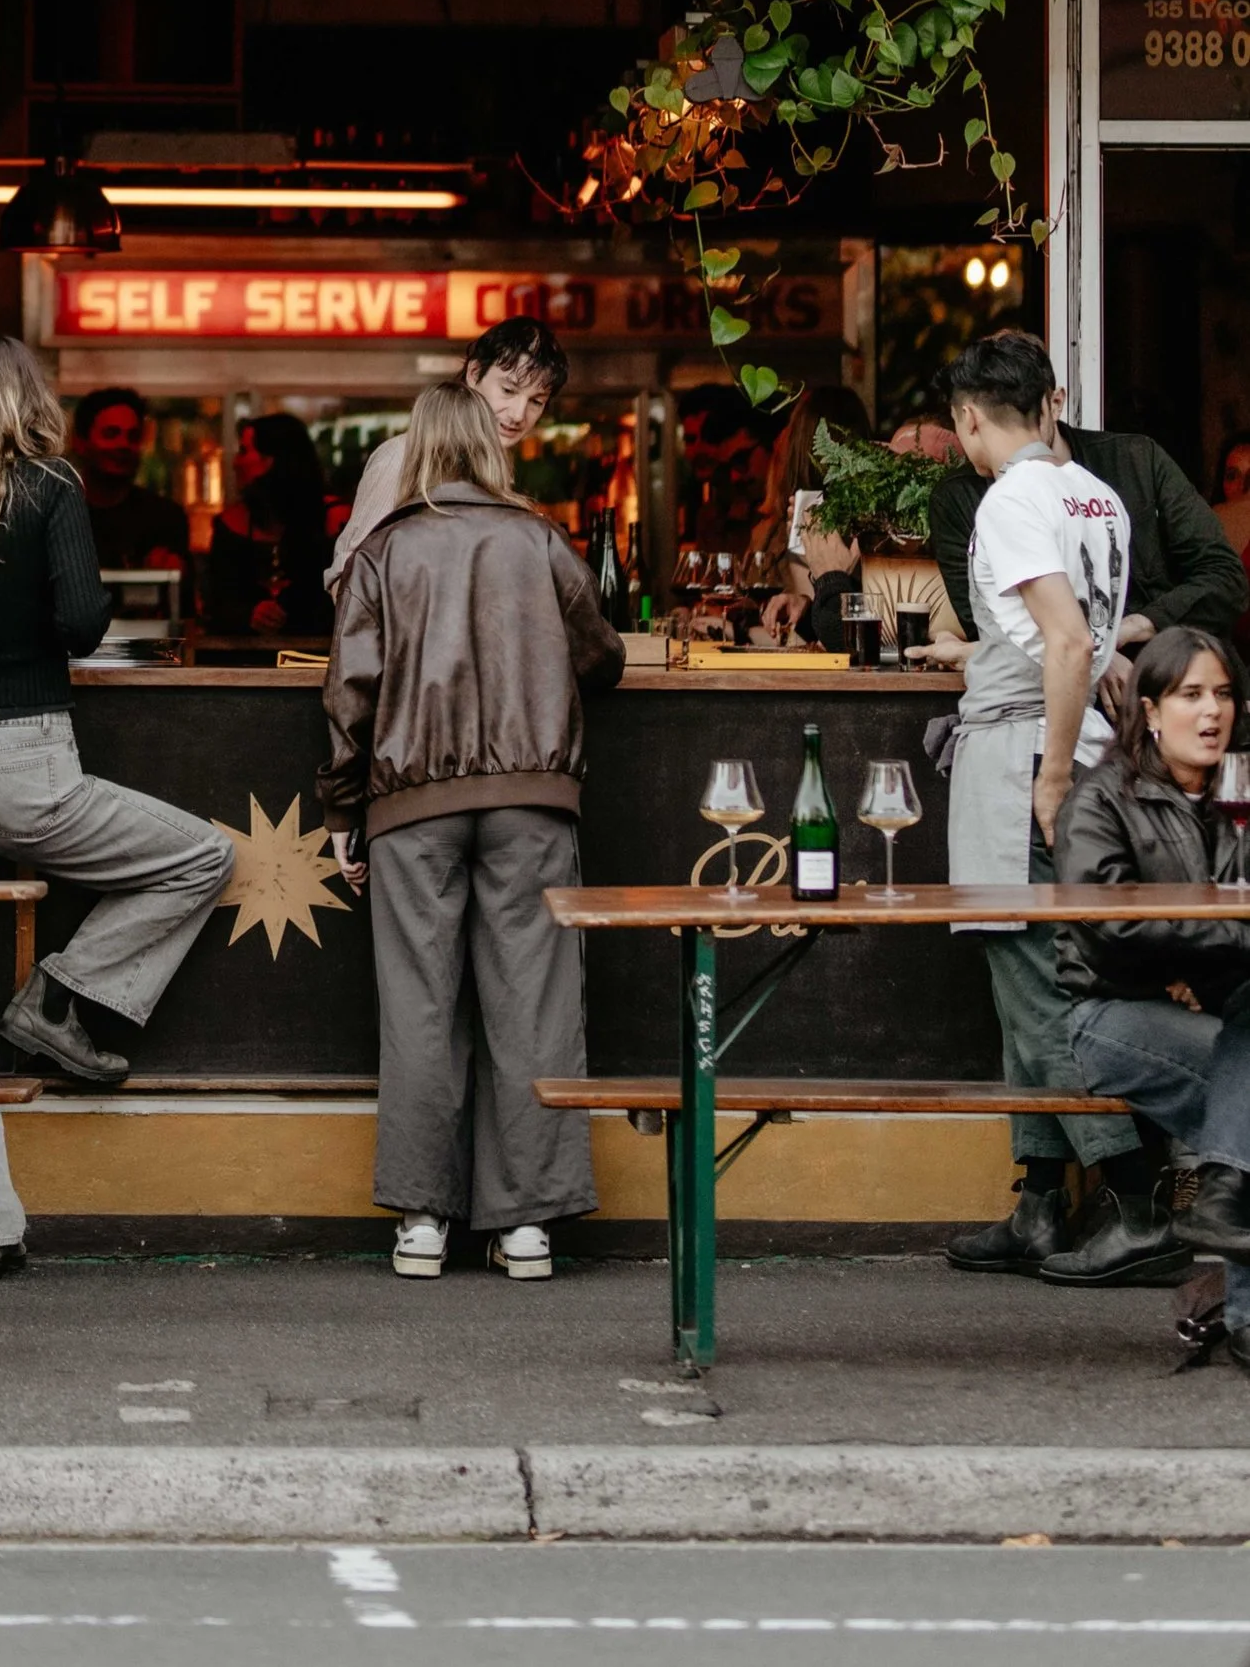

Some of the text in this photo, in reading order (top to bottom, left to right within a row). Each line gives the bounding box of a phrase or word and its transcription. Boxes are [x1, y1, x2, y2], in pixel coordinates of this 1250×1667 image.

[1144, 0, 1184, 19] 135
[1144, 30, 1224, 68] 9388
[78, 279, 218, 332] SELF
[244, 279, 427, 332] SERVE
[626, 283, 820, 332] DRKS
